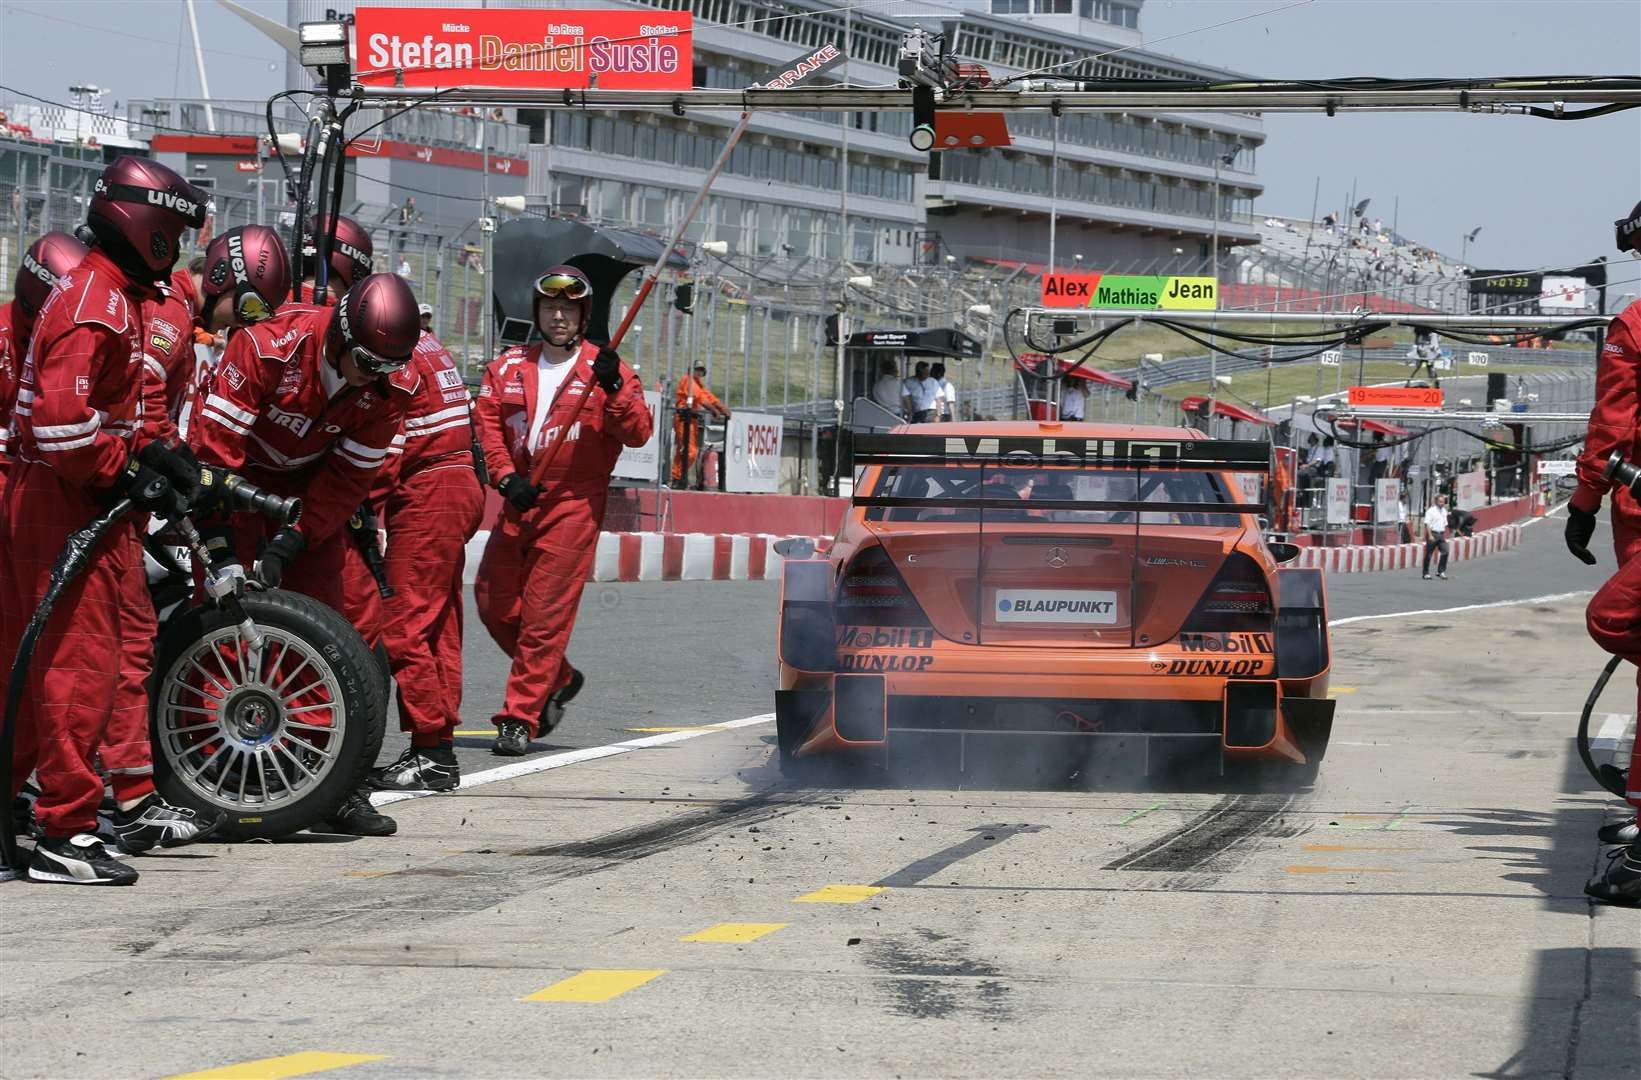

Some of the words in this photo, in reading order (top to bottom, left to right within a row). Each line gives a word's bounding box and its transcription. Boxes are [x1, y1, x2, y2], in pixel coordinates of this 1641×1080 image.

[442, 23, 470, 33] Mücke
[548, 24, 560, 34] La
[561, 25, 584, 35] Rosa
[640, 26, 679, 36] Stoddart
[369, 33, 473, 69] Stefan
[480, 35, 584, 72] Daniel
[589, 36, 678, 73] Susie
[767, 44, 841, 90] BRAKE
[147, 189, 200, 217] uvex
[228, 235, 248, 285] uvex
[255, 250, 269, 281] uvex
[1045, 277, 1089, 296] Alex
[1099, 287, 1158, 305] Mathias
[1169, 279, 1214, 299] Jean
[340, 293, 353, 341] uvex
[1322, 353, 1340, 364] 150
[1471, 353, 1488, 364] 100
[1351, 390, 1365, 402] 19
[1424, 391, 1439, 403] 20
[747, 425, 779, 456] BOSCH
[945, 438, 1115, 470] Mobil
[1014, 599, 1113, 614] BLAUPUNKT
[839, 626, 906, 648] Mobil
[1180, 632, 1254, 654] Mobil
[842, 654, 934, 673] DUNLOP
[1167, 660, 1263, 675] DUNLOP
